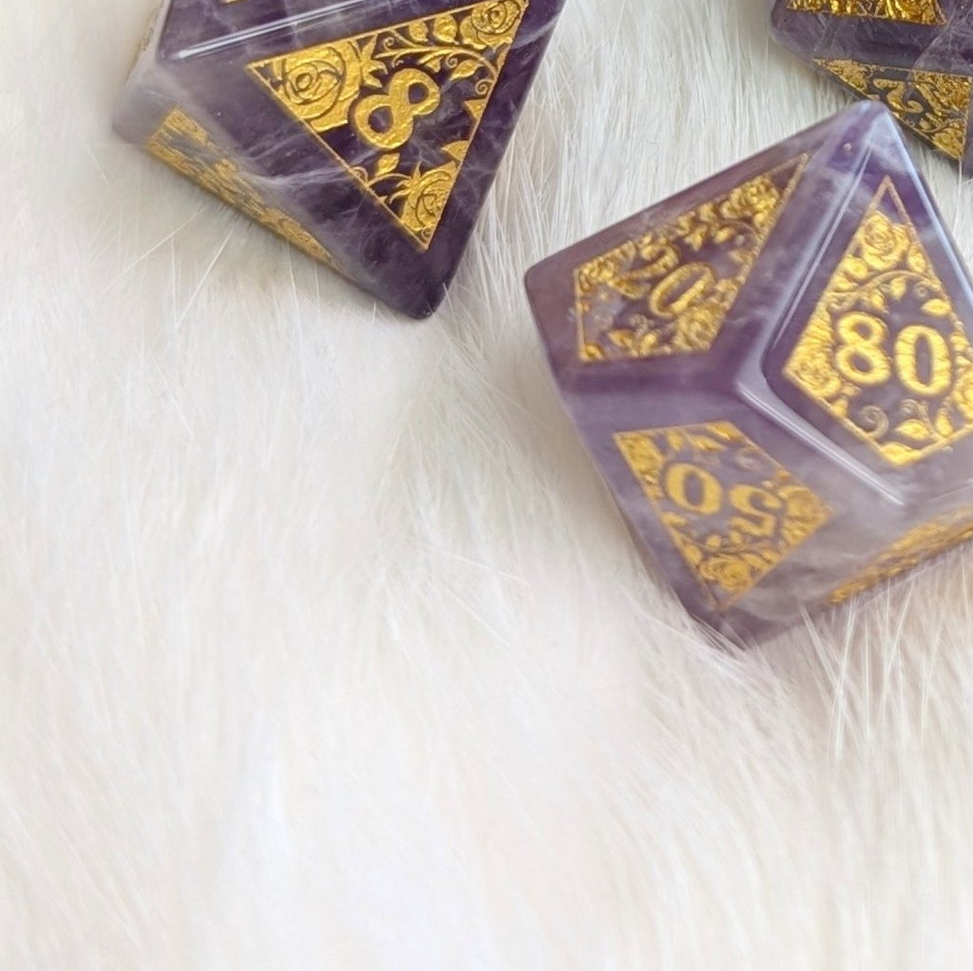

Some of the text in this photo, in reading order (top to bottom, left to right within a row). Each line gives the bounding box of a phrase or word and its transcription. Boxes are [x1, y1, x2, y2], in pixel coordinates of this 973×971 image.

[354, 67, 440, 150] 8
[613, 242, 716, 318] 20
[834, 310, 952, 396] 80
[665, 462, 783, 537] 50
